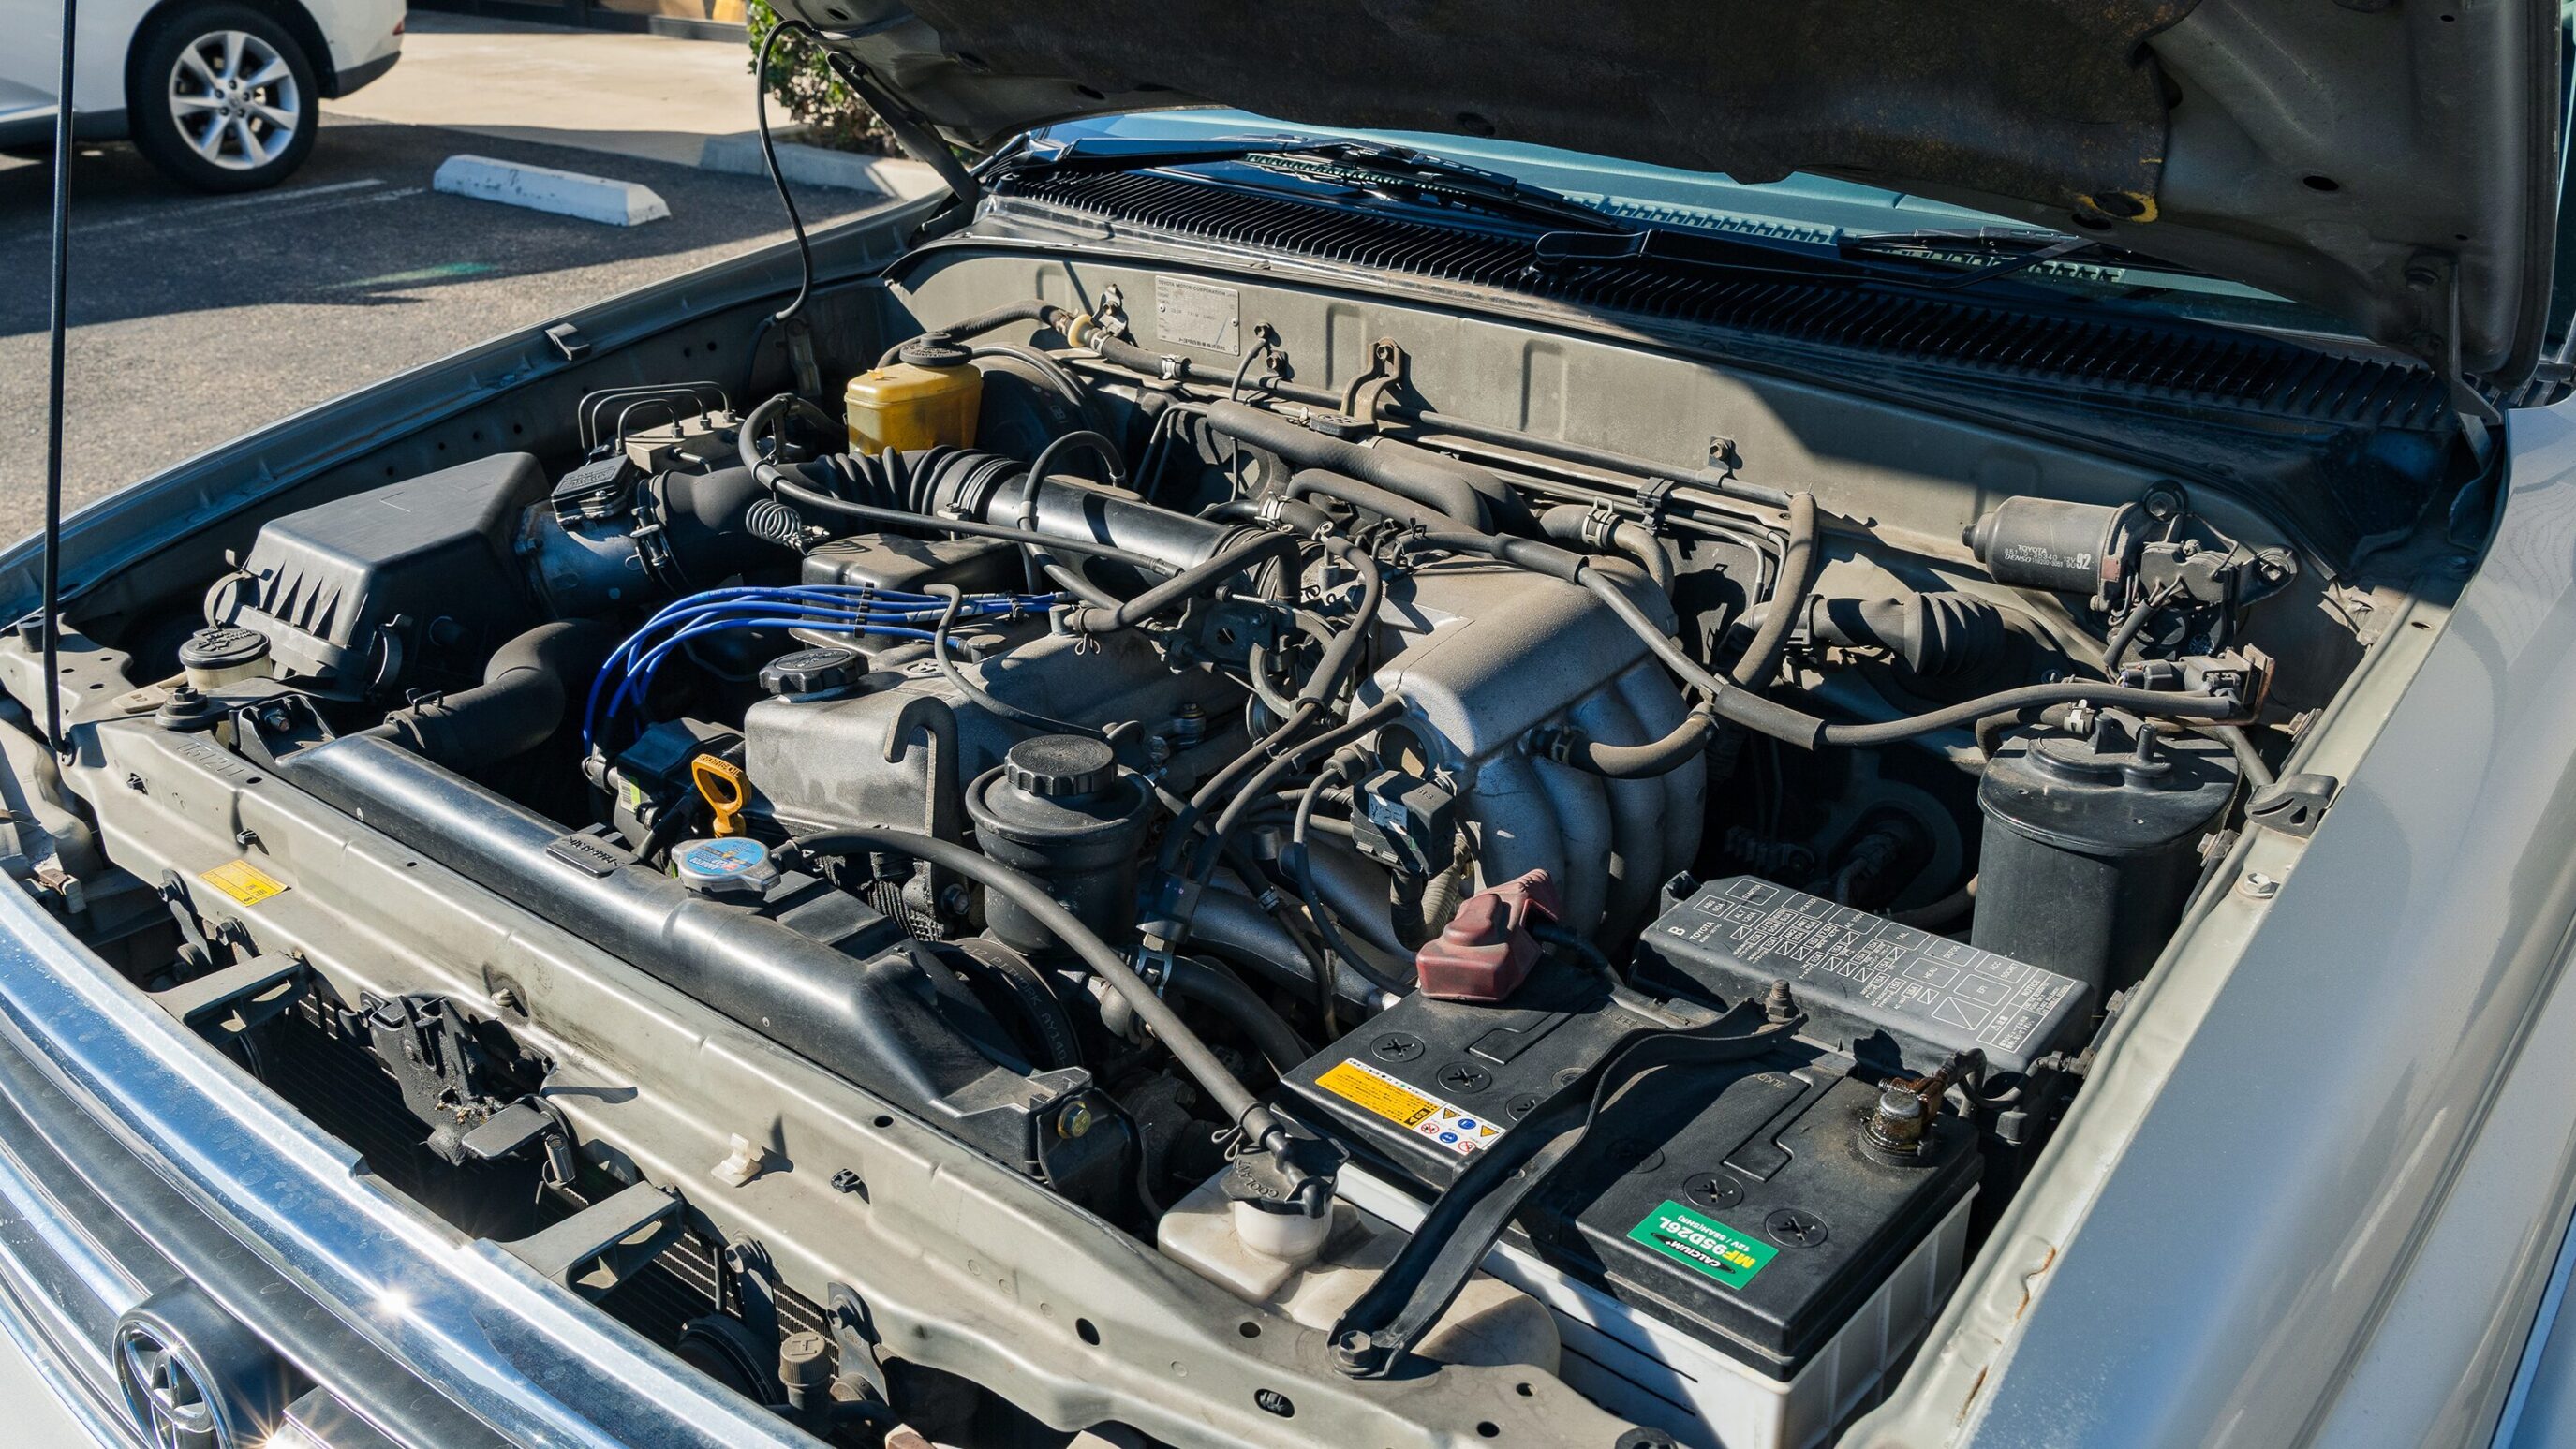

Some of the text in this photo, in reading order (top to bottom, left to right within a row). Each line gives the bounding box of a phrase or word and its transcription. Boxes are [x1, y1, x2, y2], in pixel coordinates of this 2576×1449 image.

[1192, 286, 1226, 296] CORPORATION
[2017, 544, 2047, 554] TOYOTA
[2004, 554, 2031, 563] DENSO
[2076, 553, 2092, 570] 92
[1741, 884, 1762, 898] STARTER
[1797, 897, 1818, 911] HEATER
[1733, 909, 1746, 918] ALT
[1741, 911, 1757, 922] 120A
[1667, 925, 1686, 936] B
[1688, 921, 1715, 940] TOYOTA
[1895, 931, 1909, 940] TAIL
[1943, 944, 1961, 958] DEFOG
[1989, 960, 2001, 970] ACC
[2000, 962, 2019, 978] SOCKET
[1922, 966, 1938, 979] HEAD
[1976, 984, 1988, 993] EFI
[2021, 979, 2040, 996] NOTICE
[1658, 1216, 1756, 1269] MF95D26L
[1732, 1241, 1751, 1252] 12V
